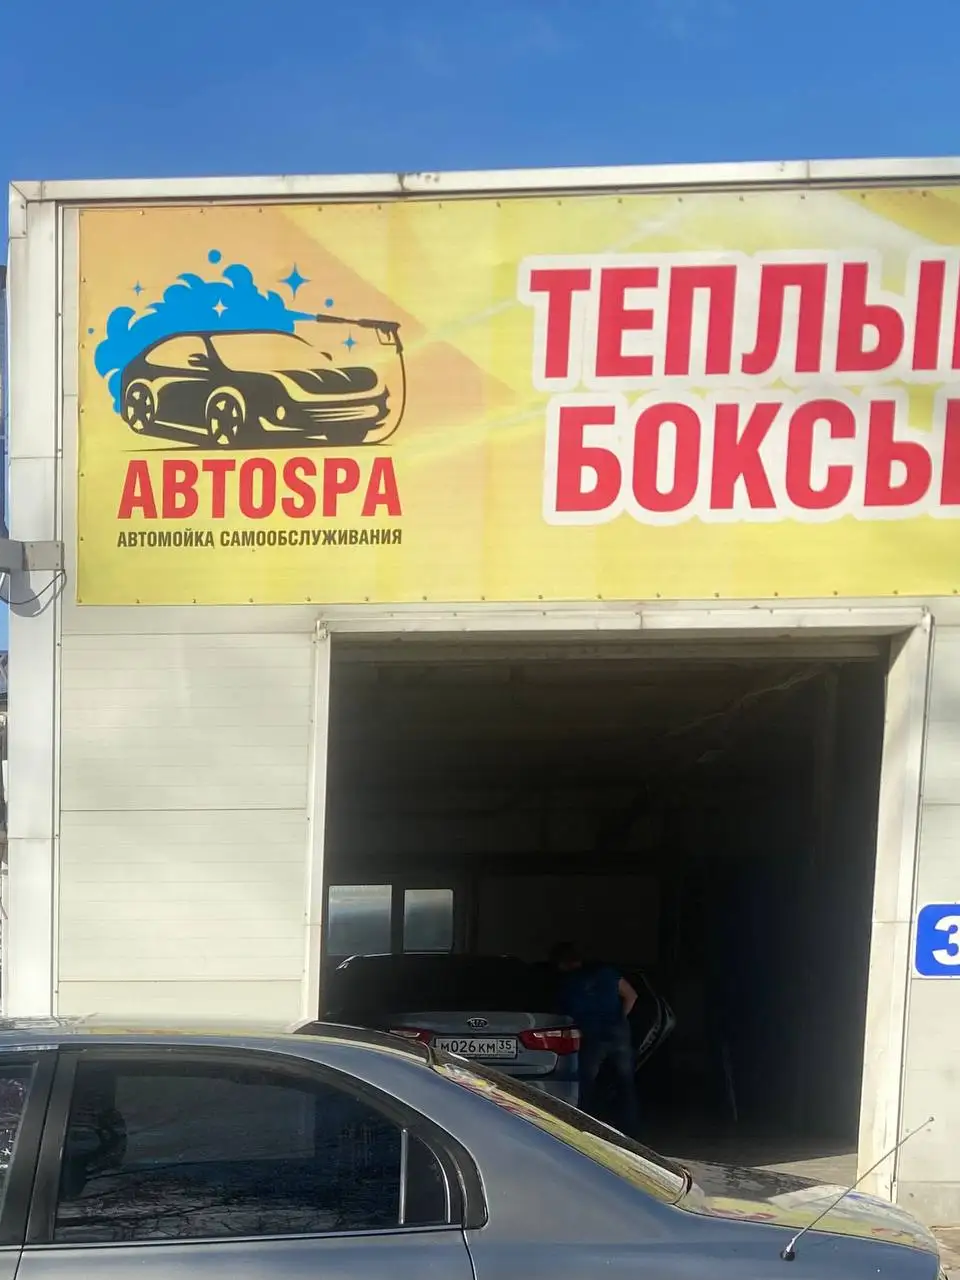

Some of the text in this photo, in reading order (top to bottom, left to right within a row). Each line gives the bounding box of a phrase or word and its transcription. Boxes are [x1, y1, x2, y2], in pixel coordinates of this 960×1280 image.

[530, 259, 960, 378] ТЕПЛЫ
[117, 456, 403, 520] АВТОSPA
[555, 397, 960, 512] БОКСЫ
[117, 528, 403, 549] АВТОМОЙКА САМООБСЛУЖИВАНИЯ
